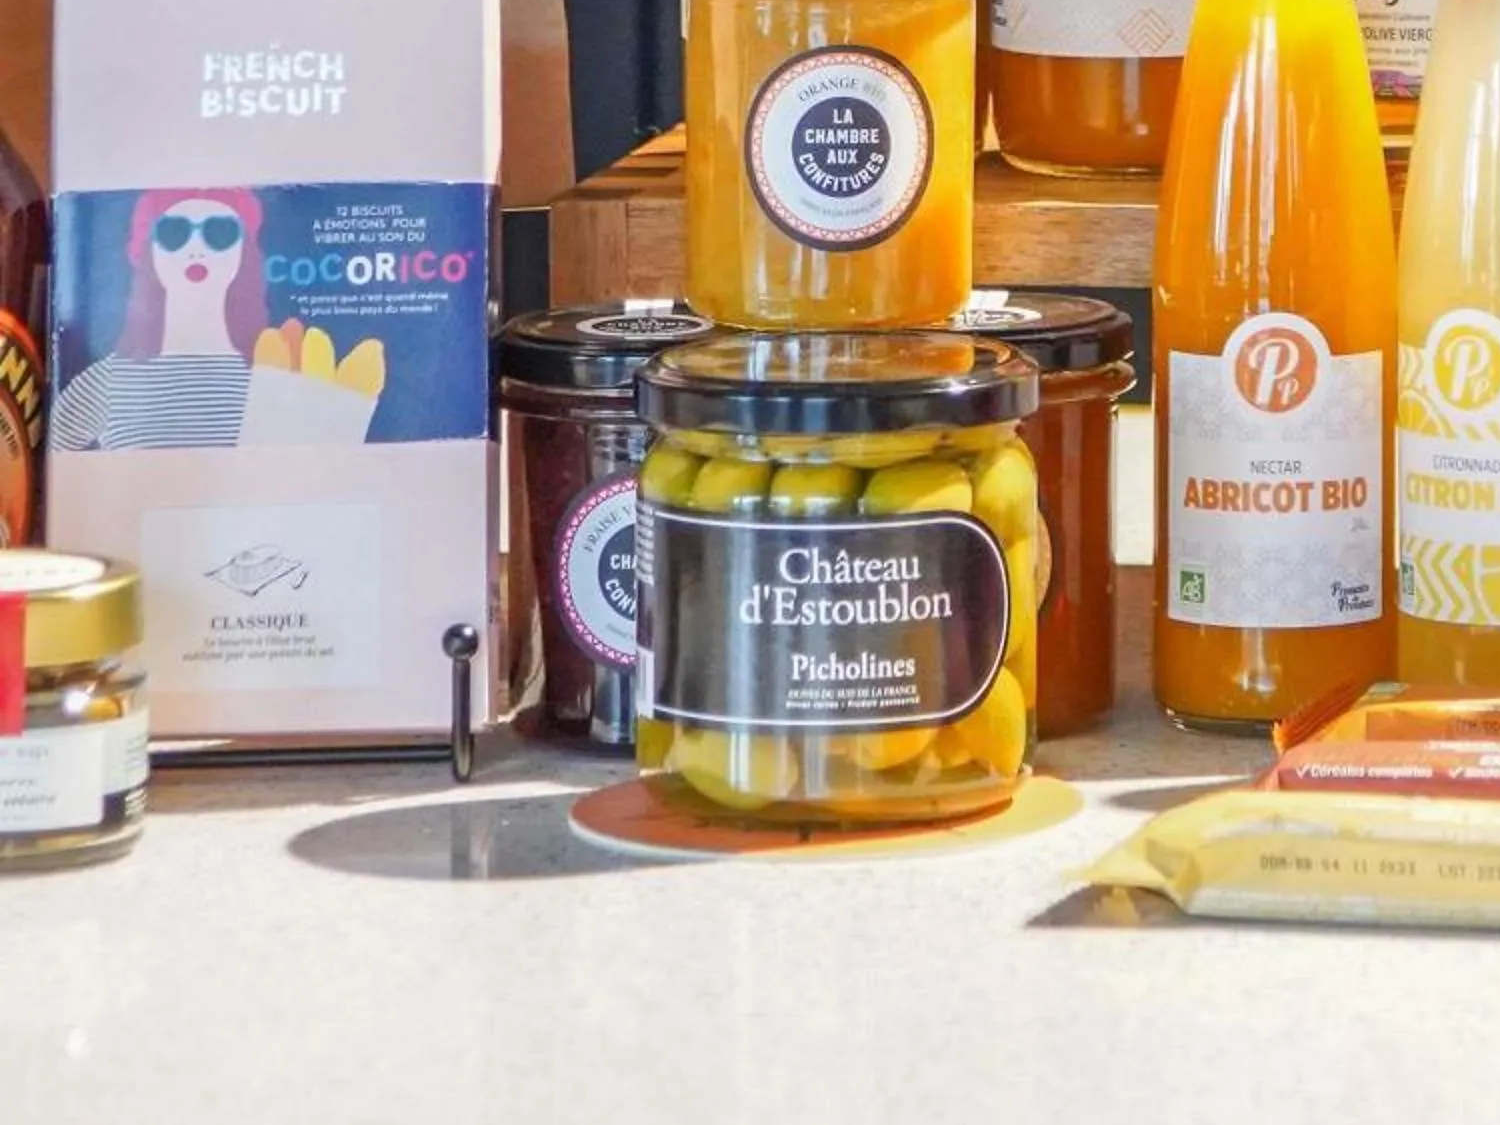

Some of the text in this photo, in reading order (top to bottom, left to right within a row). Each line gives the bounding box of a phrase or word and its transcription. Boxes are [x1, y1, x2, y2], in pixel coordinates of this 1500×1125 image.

[203, 47, 345, 83] FRENCH
[200, 83, 348, 118] BISCUIT
[798, 76, 860, 102] ORANGE
[832, 109, 853, 124] LA
[805, 128, 880, 144] CHAMBRE
[826, 149, 859, 164] AUX
[799, 152, 884, 192] CONFITURES
[392, 217, 426, 229] POUR
[358, 231, 376, 243] AU
[407, 230, 425, 242] DU
[1250, 460, 1302, 475] NECTAR
[1184, 476, 1368, 513] ABRICOT BIO
[1405, 473, 1495, 512] CITRON
[779, 546, 921, 584] Château
[739, 582, 953, 625] d'Estoublon
[210, 613, 309, 632] CLASSIQUE
[791, 651, 917, 681] Picholines
[884, 683, 918, 697] FRANCE
